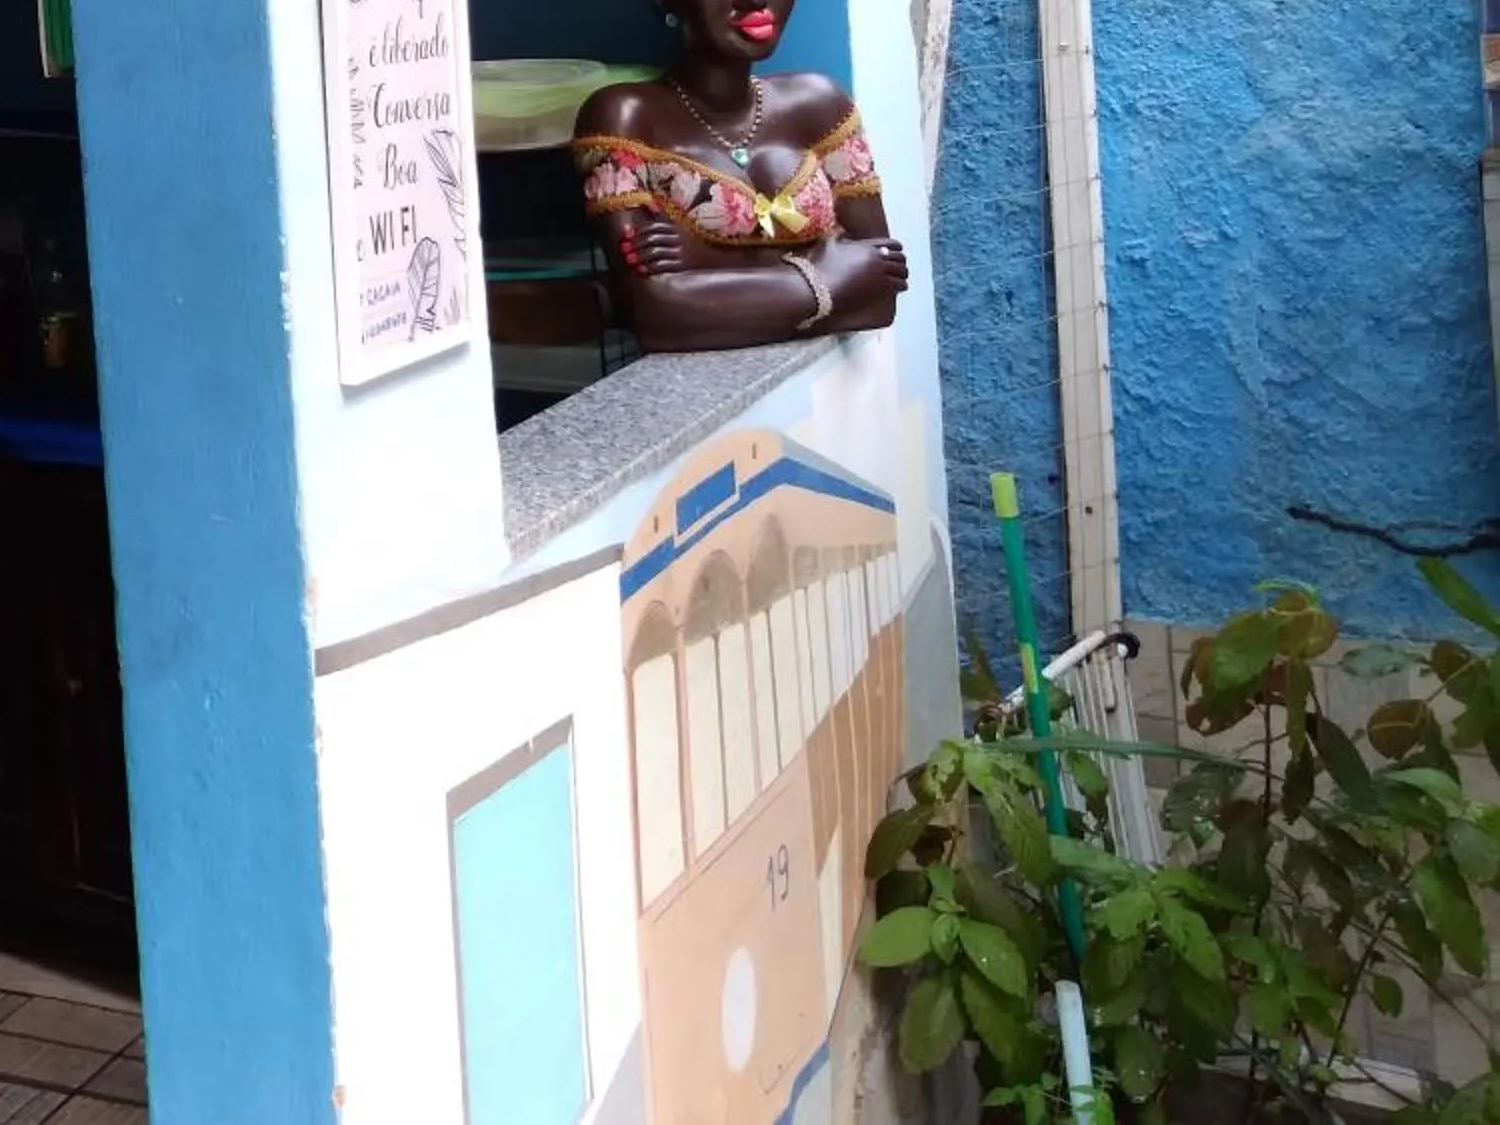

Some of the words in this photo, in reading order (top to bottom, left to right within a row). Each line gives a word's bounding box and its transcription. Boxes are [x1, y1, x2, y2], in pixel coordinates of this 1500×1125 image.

[381, 11, 449, 66] liberado
[370, 81, 452, 129] Conversa
[380, 142, 419, 192] Boa
[762, 842, 791, 912] 19
